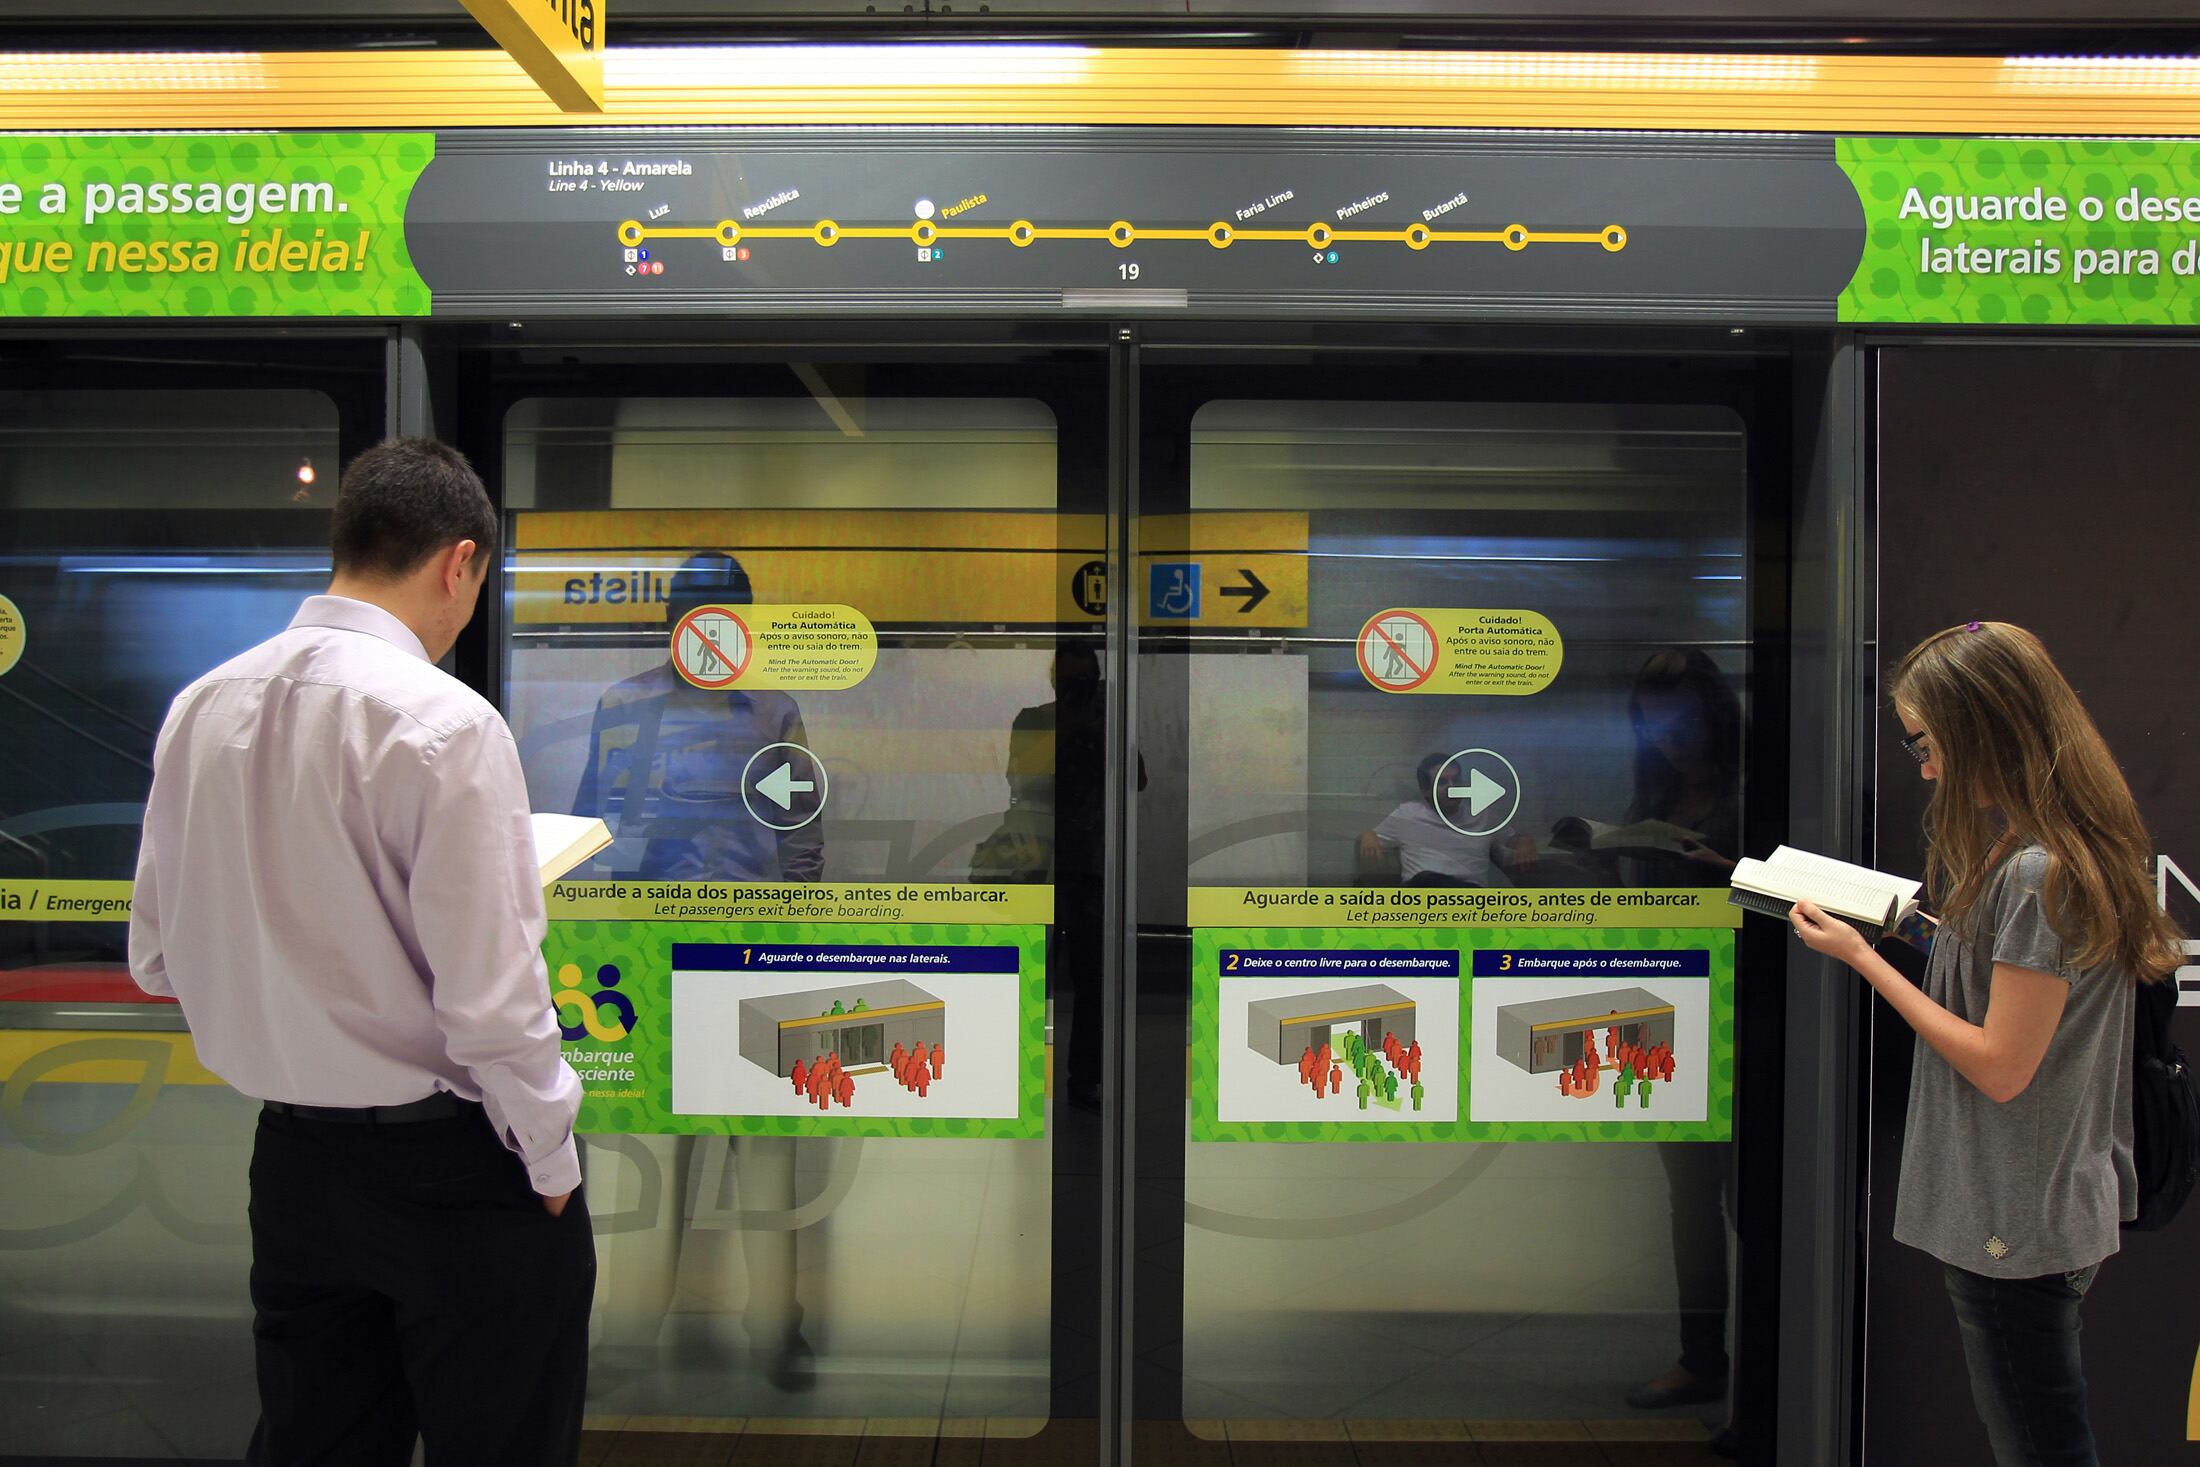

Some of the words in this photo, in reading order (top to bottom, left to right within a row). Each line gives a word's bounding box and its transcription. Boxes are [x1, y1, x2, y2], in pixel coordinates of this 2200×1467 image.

[549, 161, 594, 176] Linha
[597, 161, 608, 176] 4
[622, 160, 692, 176] Amarela
[549, 179, 577, 192] Line
[579, 180, 588, 192] 4
[601, 179, 644, 192] Yellow
[39, 183, 67, 213] a
[85, 181, 348, 224] passagem.
[743, 189, 800, 220] República
[941, 192, 988, 220] Paulista
[1235, 201, 1265, 222] Faria
[1264, 189, 1294, 209] Lima
[1336, 190, 1390, 221] Pinheiros
[1422, 191, 1469, 222] Butantã
[1898, 186, 2067, 229] Aguarde
[2078, 196, 2104, 221] o
[649, 203, 671, 220] Luz
[87, 239, 219, 273] nessa
[234, 229, 370, 273] ideia!
[1920, 237, 2061, 275] laterais
[2073, 247, 2159, 283] para
[2172, 240, 2200, 276] d
[1118, 263, 1140, 280] 19
[791, 610, 836, 620] Cuidado!
[1479, 615, 1522, 625] Cuidado!
[771, 621, 798, 630] Porta
[800, 621, 856, 630] Automática
[1458, 626, 1484, 635] Porta
[1487, 626, 1543, 636] Automática
[759, 632, 782, 642] Após
[791, 632, 815, 640] aviso
[816, 633, 849, 641] sonoro,
[851, 632, 868, 640] não
[1446, 636, 1469, 646] Após
[1478, 636, 1501, 645] aviso
[1503, 638, 1535, 646] sonoro,
[1537, 637, 1555, 646] não
[767, 643, 791, 651] entre
[793, 643, 804, 651] ou
[806, 642, 824, 651] saia
[825, 642, 837, 651] do
[839, 642, 863, 651] trem.
[1454, 647, 1477, 655] entre
[1493, 647, 1510, 656] saia
[1512, 646, 1524, 656] do
[1526, 648, 1549, 656] trem.
[1479, 671, 1505, 679] warning
[1, 888, 21, 910] ia
[29, 889, 39, 910] /
[46, 895, 132, 915] Emergenc
[552, 884, 627, 901] Aguarde
[632, 887, 642, 899] a
[647, 884, 692, 899] saída
[702, 884, 728, 900] dos
[733, 885, 839, 904] passageiros,
[844, 887, 891, 902] antes
[896, 886, 918, 902] de
[924, 886, 1009, 902] embarcar.
[1242, 890, 1319, 908] Aguarde
[1324, 893, 1335, 905] a
[1339, 890, 1385, 906] saída
[1390, 890, 1422, 906] dos
[1427, 891, 1533, 909] passageiros,
[1538, 893, 1585, 906] antes
[1590, 891, 1612, 906] de
[1616, 891, 1700, 907] embarcar.
[654, 903, 676, 915] Let
[679, 904, 754, 918] passengers
[758, 904, 783, 916] exit
[787, 903, 834, 917] before
[838, 904, 905, 920] boarding.
[1347, 909, 1369, 922] Let
[1372, 910, 1448, 924] passengers
[1451, 910, 1477, 922] exit
[1481, 909, 1527, 922] before
[1531, 910, 1598, 924] boarding.
[743, 948, 752, 965] 1
[758, 952, 804, 964] Aguarde
[806, 955, 814, 963] o
[816, 953, 887, 965] desembarque
[888, 955, 907, 964] nas
[909, 953, 951, 964] laterais.
[1226, 954, 1239, 970] 2
[1243, 957, 1273, 967] Deixe
[1275, 960, 1283, 968] o
[1284, 959, 1318, 968] centro
[1319, 957, 1342, 968] livre
[1343, 960, 1368, 969] para
[1370, 960, 1377, 968] o
[1379, 957, 1451, 970] desembarque.
[1500, 954, 1512, 970] 3
[1518, 957, 1570, 970] Embarque
[1573, 958, 1598, 970] após
[1600, 960, 1607, 968] o
[1609, 957, 1682, 970] desembarque.
[560, 1047, 634, 1066] mbarque
[578, 1066, 635, 1081] sciente
[589, 1090, 616, 1098] nessa
[617, 1089, 645, 1098] ideia!
